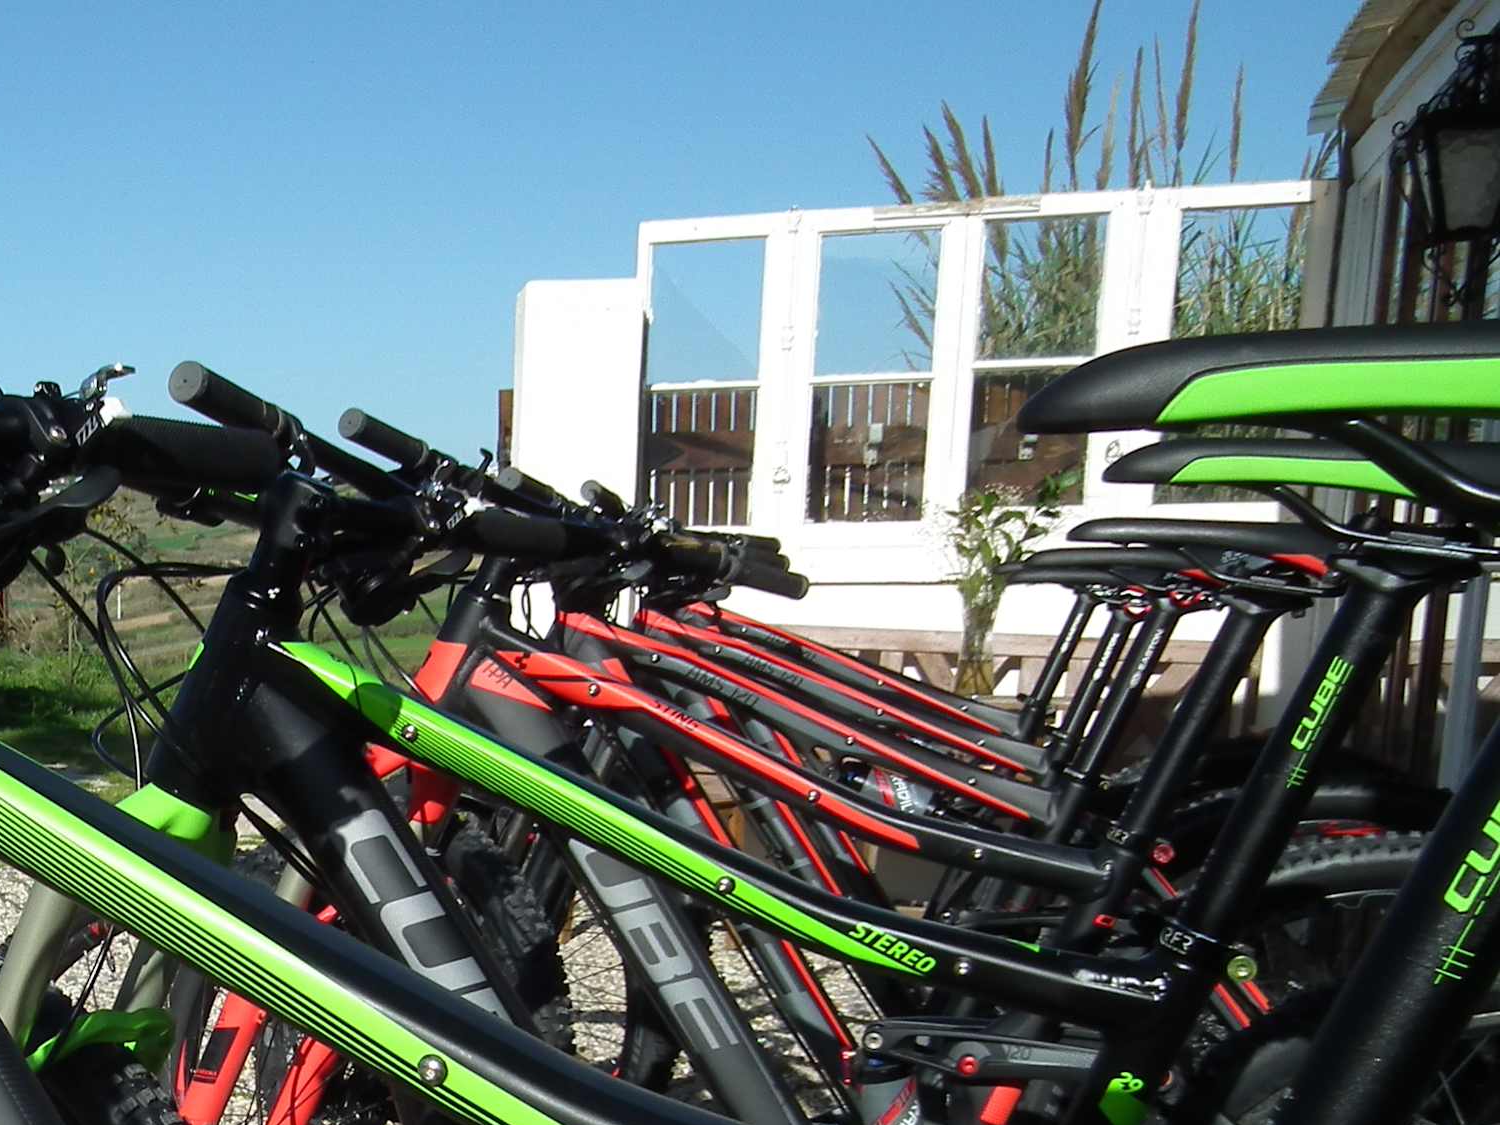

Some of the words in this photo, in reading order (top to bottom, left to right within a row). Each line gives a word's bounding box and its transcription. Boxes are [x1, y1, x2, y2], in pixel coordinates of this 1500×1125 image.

[684, 665, 726, 693] AMS
[1290, 656, 1348, 750] CUBE
[848, 920, 937, 975] STEREO
